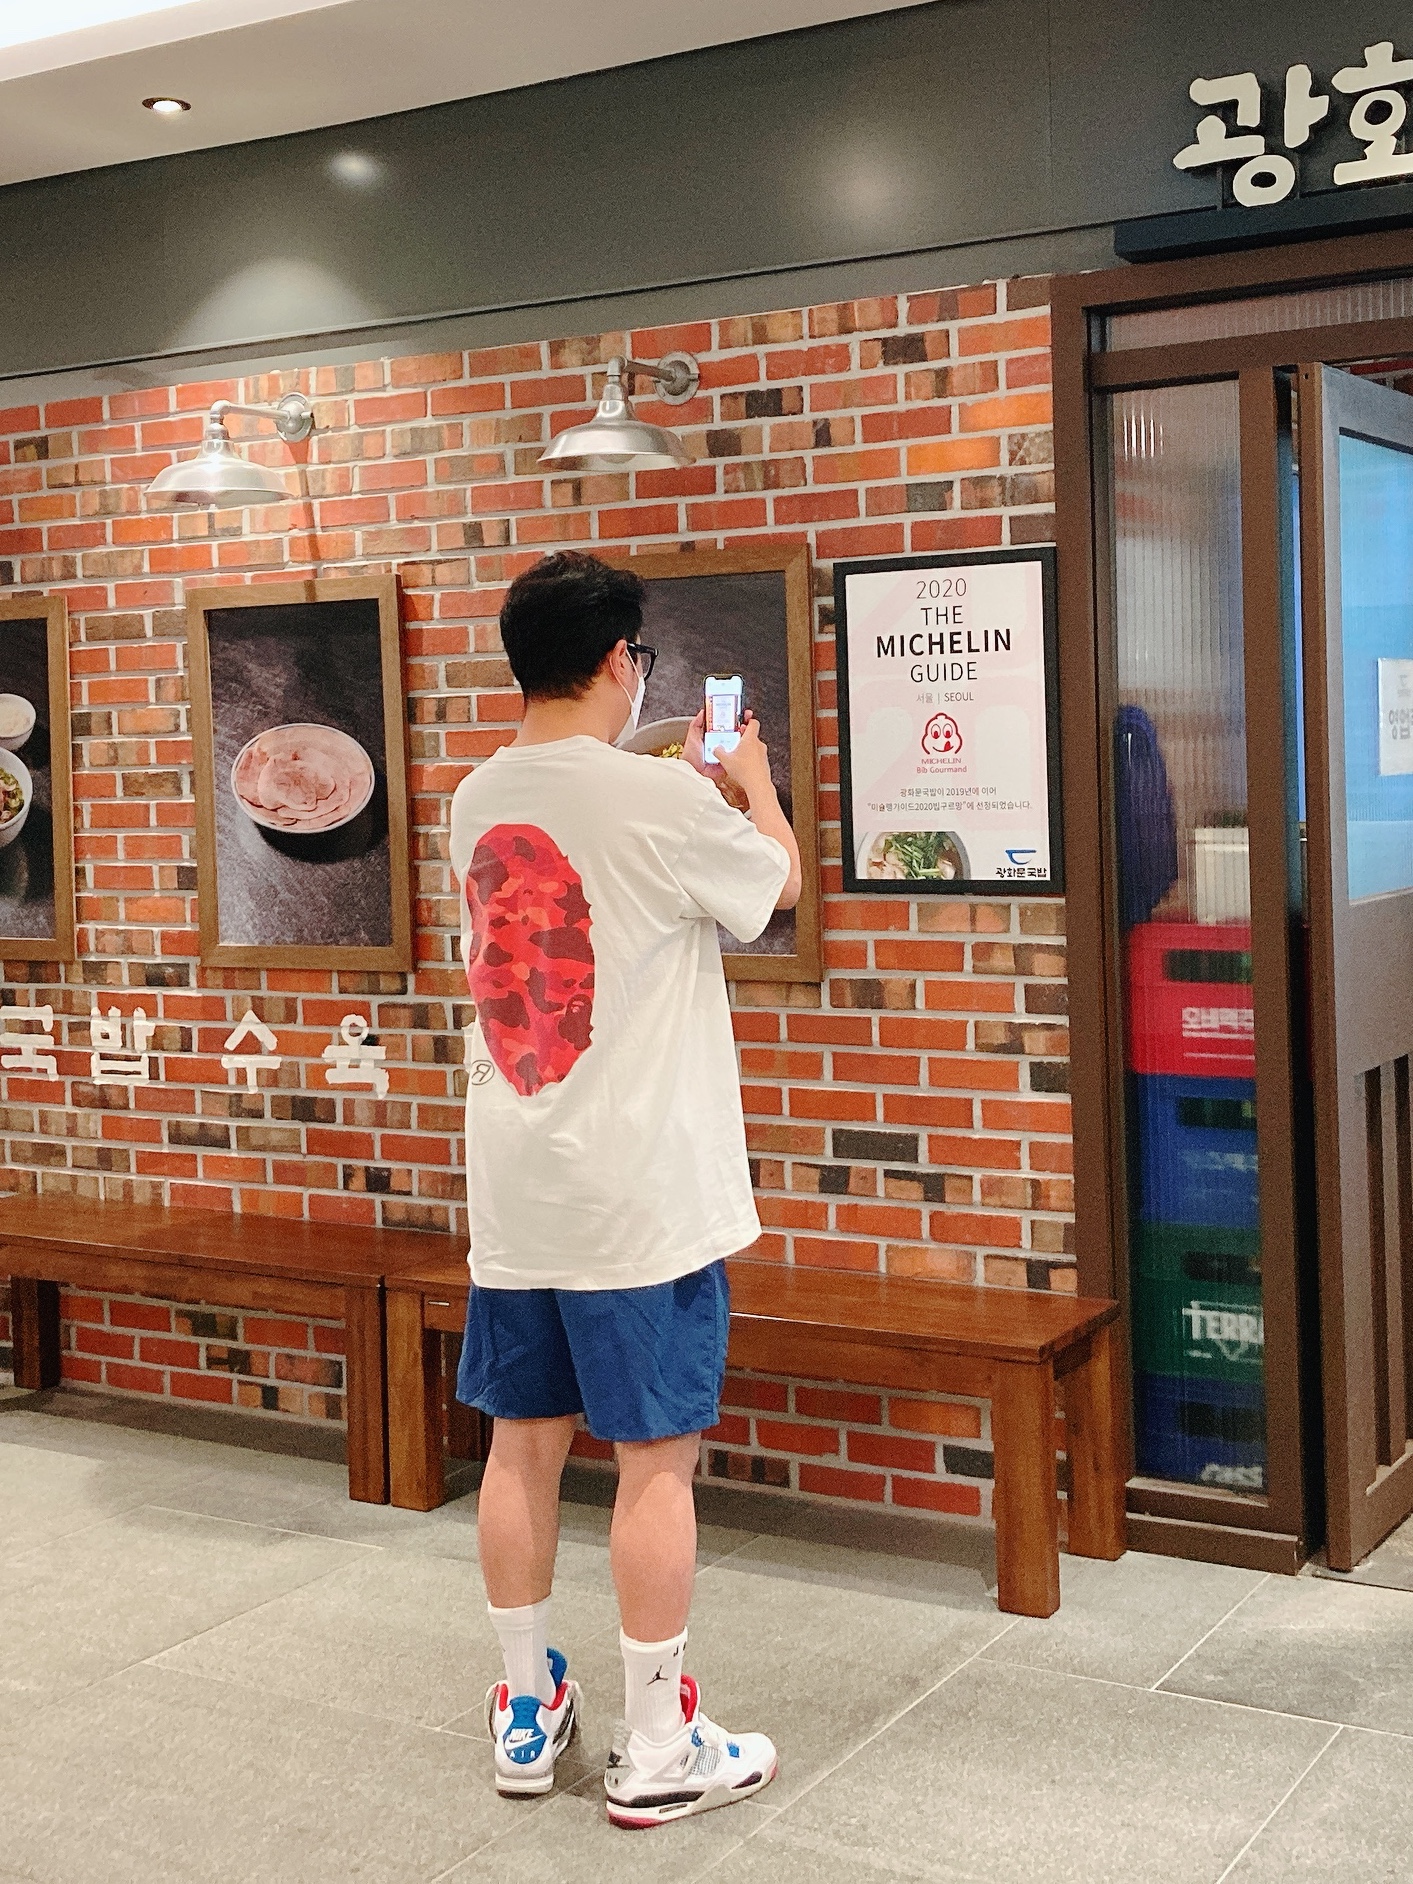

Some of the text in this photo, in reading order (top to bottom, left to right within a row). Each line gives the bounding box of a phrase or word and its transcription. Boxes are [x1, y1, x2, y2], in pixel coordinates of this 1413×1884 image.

[916, 578, 967, 599] 2020
[921, 605, 964, 626] THE
[877, 628, 1011, 658] MICHELIN
[910, 662, 977, 683] GUIDE
[916, 692, 974, 704] 서울 SEOUL
[916, 766, 967, 774] Bib Gourmand
[981, 786, 997, 796] 이어
[509, 1728, 535, 1742] NIKE
[510, 1750, 536, 1759] AIR
